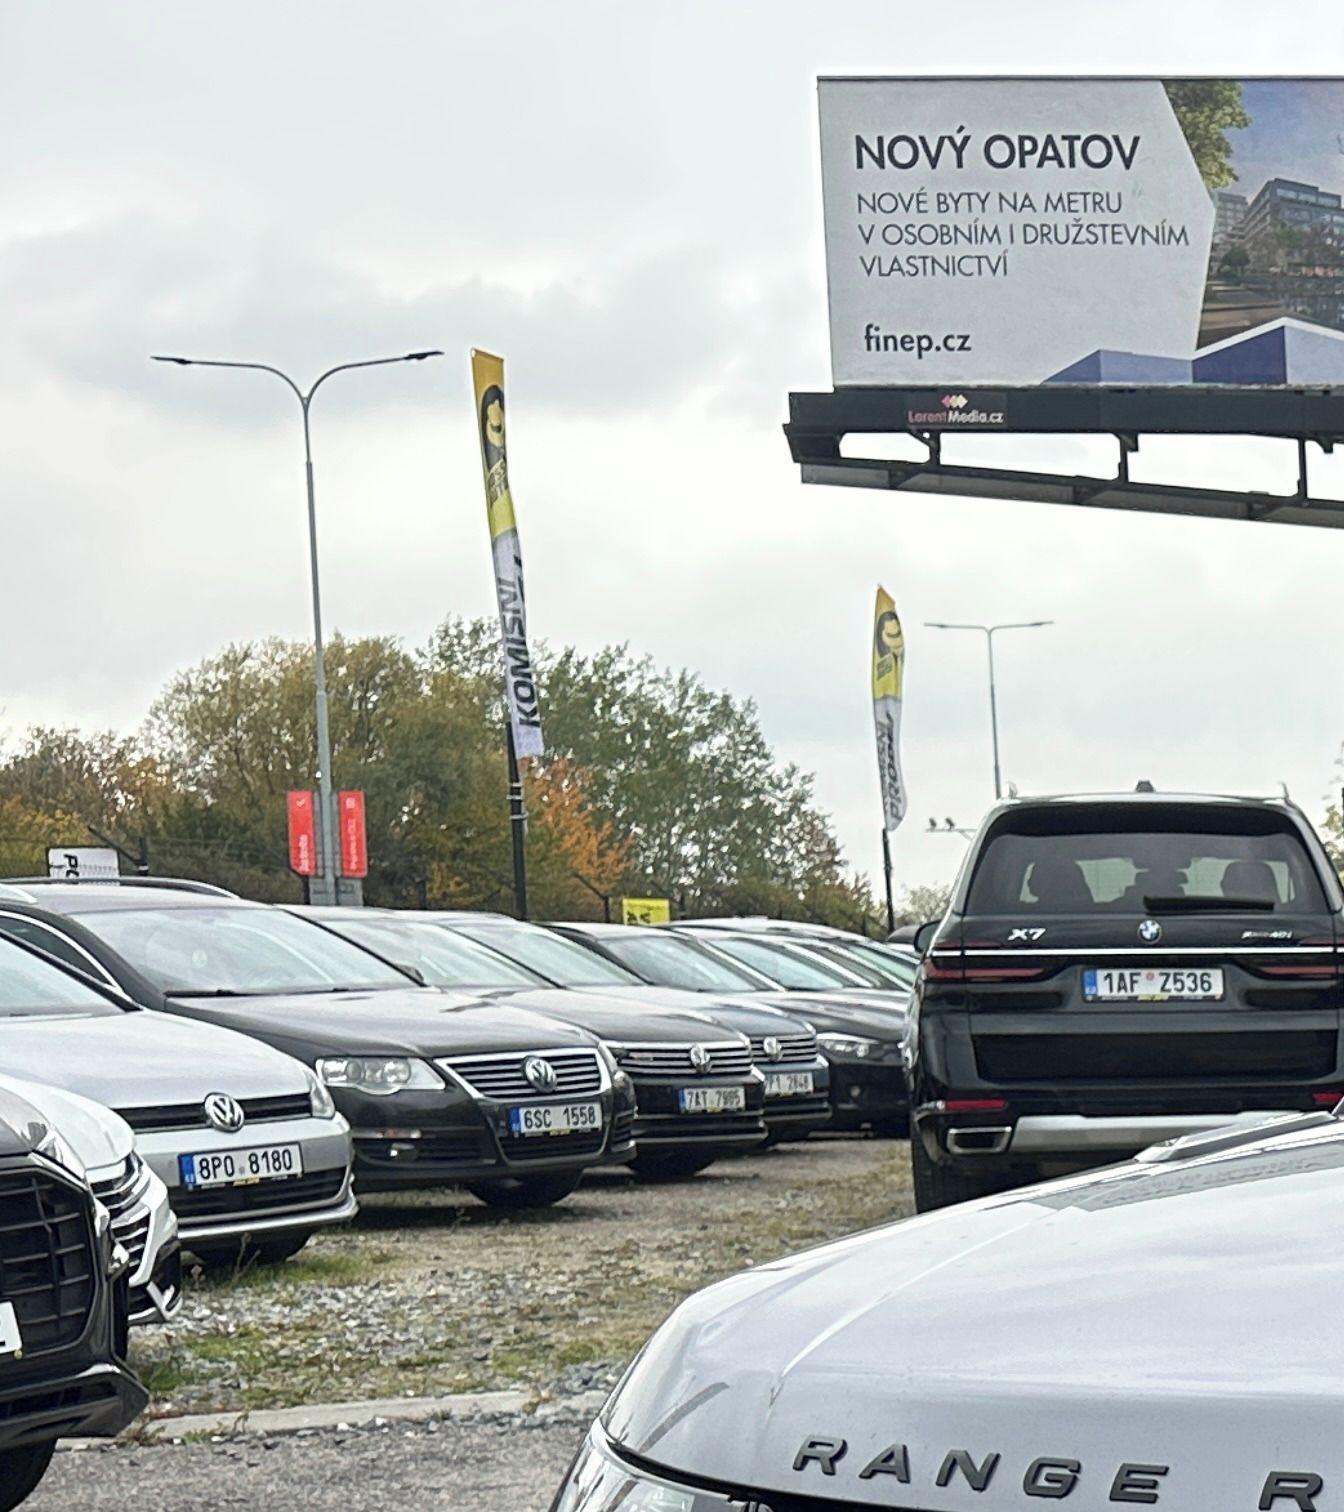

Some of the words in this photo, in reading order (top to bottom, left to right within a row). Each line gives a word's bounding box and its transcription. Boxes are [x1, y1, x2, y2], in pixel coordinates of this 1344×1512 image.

[855, 125, 972, 170] NOVÝ
[983, 134, 1141, 170] OPATOV
[857, 187, 928, 214] NOVÉ
[936, 191, 990, 214] BYTY
[999, 191, 1036, 213] NA
[1043, 191, 1122, 214] METRU
[858, 223, 875, 245] V
[881, 218, 1002, 246] OSOBNÍM
[1008, 223, 1015, 245] I
[1023, 218, 1190, 247] DRUŽSTEVNÍM
[859, 249, 1009, 278] VLASTNICTVÍ
[864, 324, 972, 360] finep.cz
[1008, 927, 1046, 941] X7
[1103, 971, 1141, 993] 1AF
[1159, 971, 1212, 993] Z536
[523, 1108, 552, 1129] 6SC
[563, 1106, 596, 1126] 1558
[248, 1149, 293, 1174] 8180
[792, 1433, 1170, 1504] RANGE
